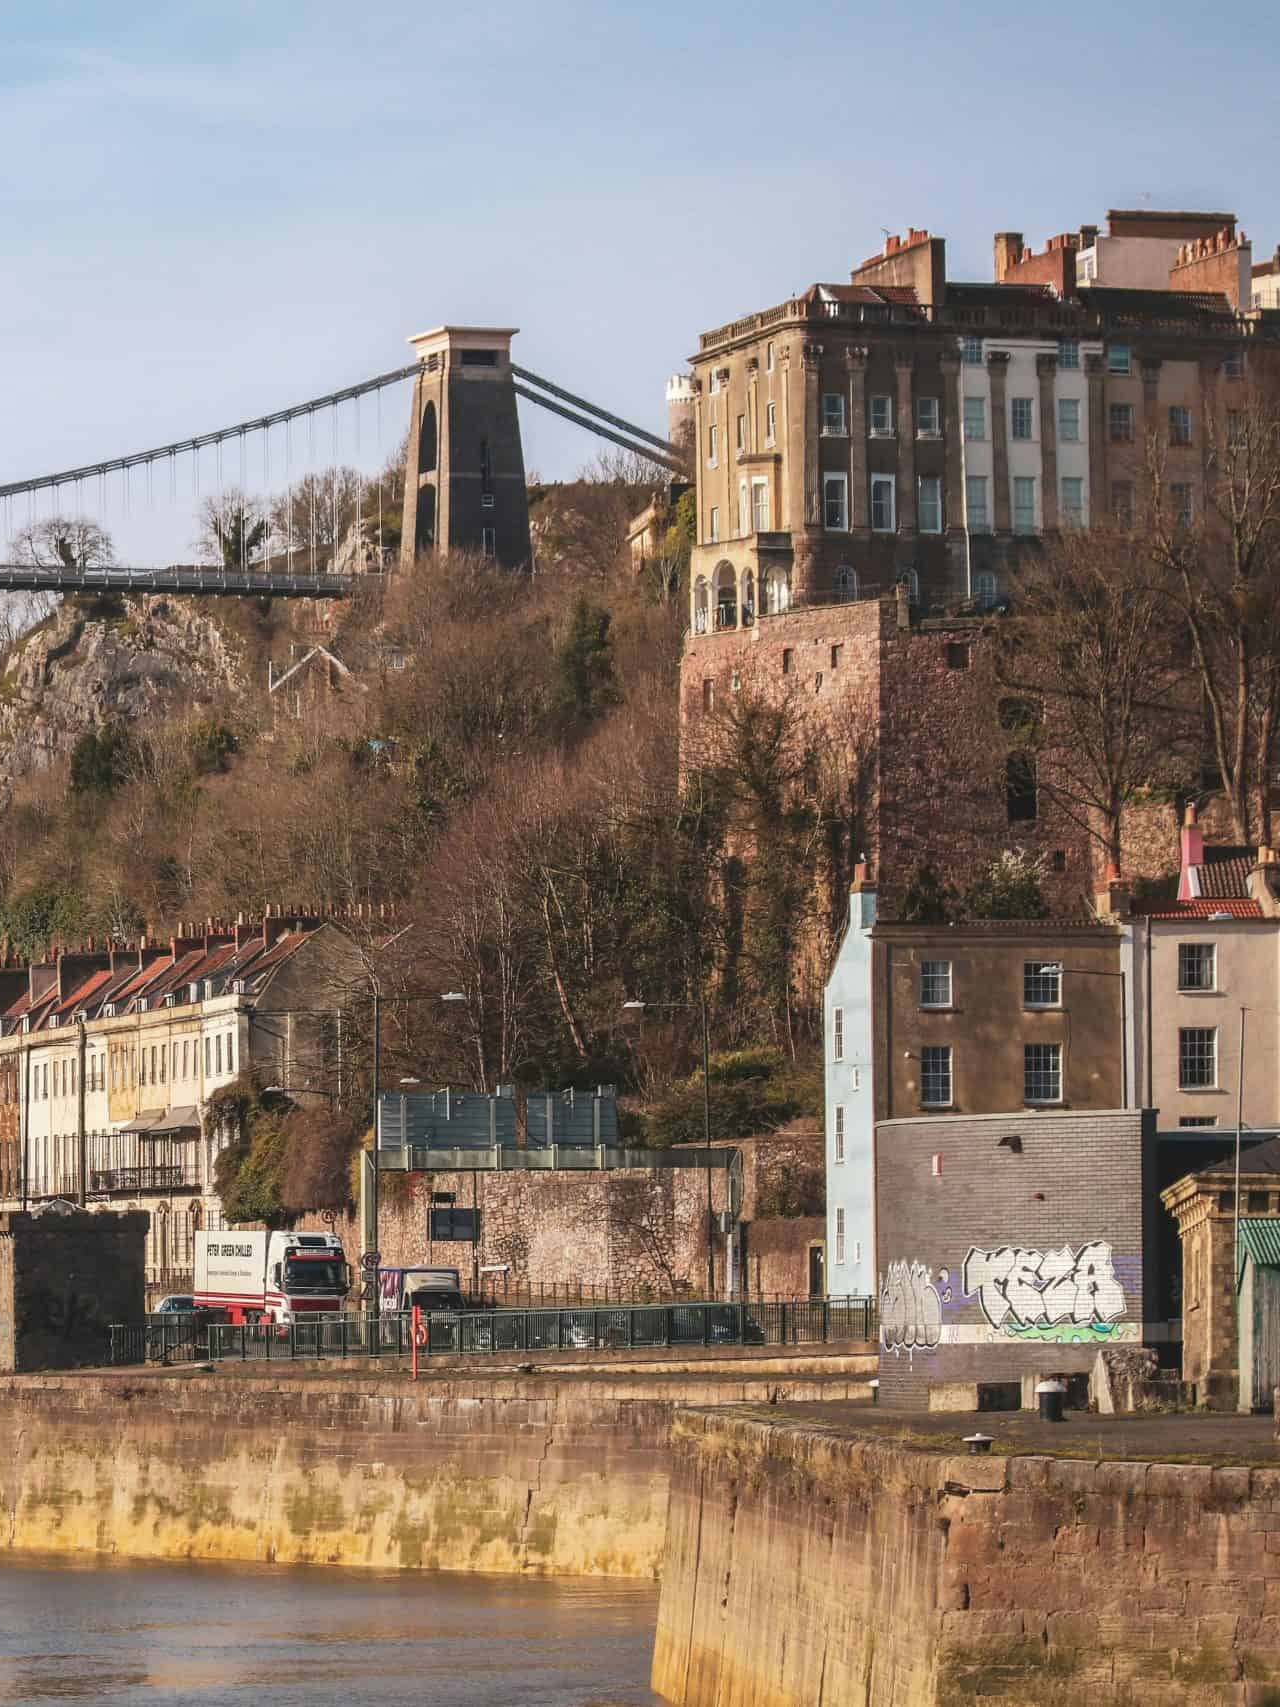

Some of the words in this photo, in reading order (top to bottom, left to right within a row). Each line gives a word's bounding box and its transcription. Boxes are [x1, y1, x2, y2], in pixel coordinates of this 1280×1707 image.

[207, 1244, 219, 1256] PETER
[221, 1244, 234, 1256] GREEN
[235, 1244, 252, 1257] CHILLED
